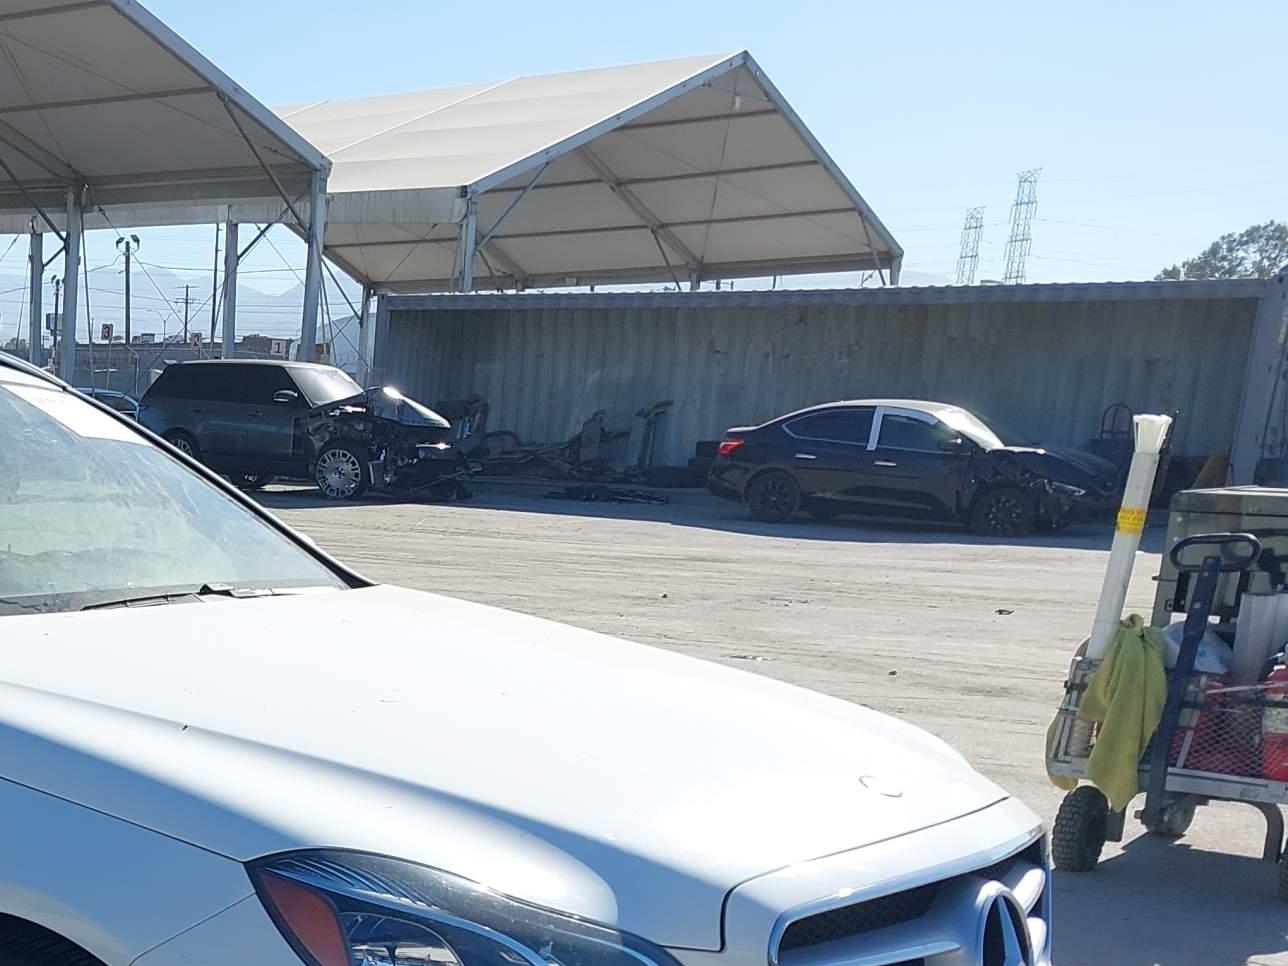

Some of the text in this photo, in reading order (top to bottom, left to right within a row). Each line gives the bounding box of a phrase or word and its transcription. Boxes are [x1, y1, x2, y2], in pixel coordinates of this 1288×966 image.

[103, 326, 111, 340] 3
[193, 334, 200, 347] 2
[274, 342, 282, 354] 1
